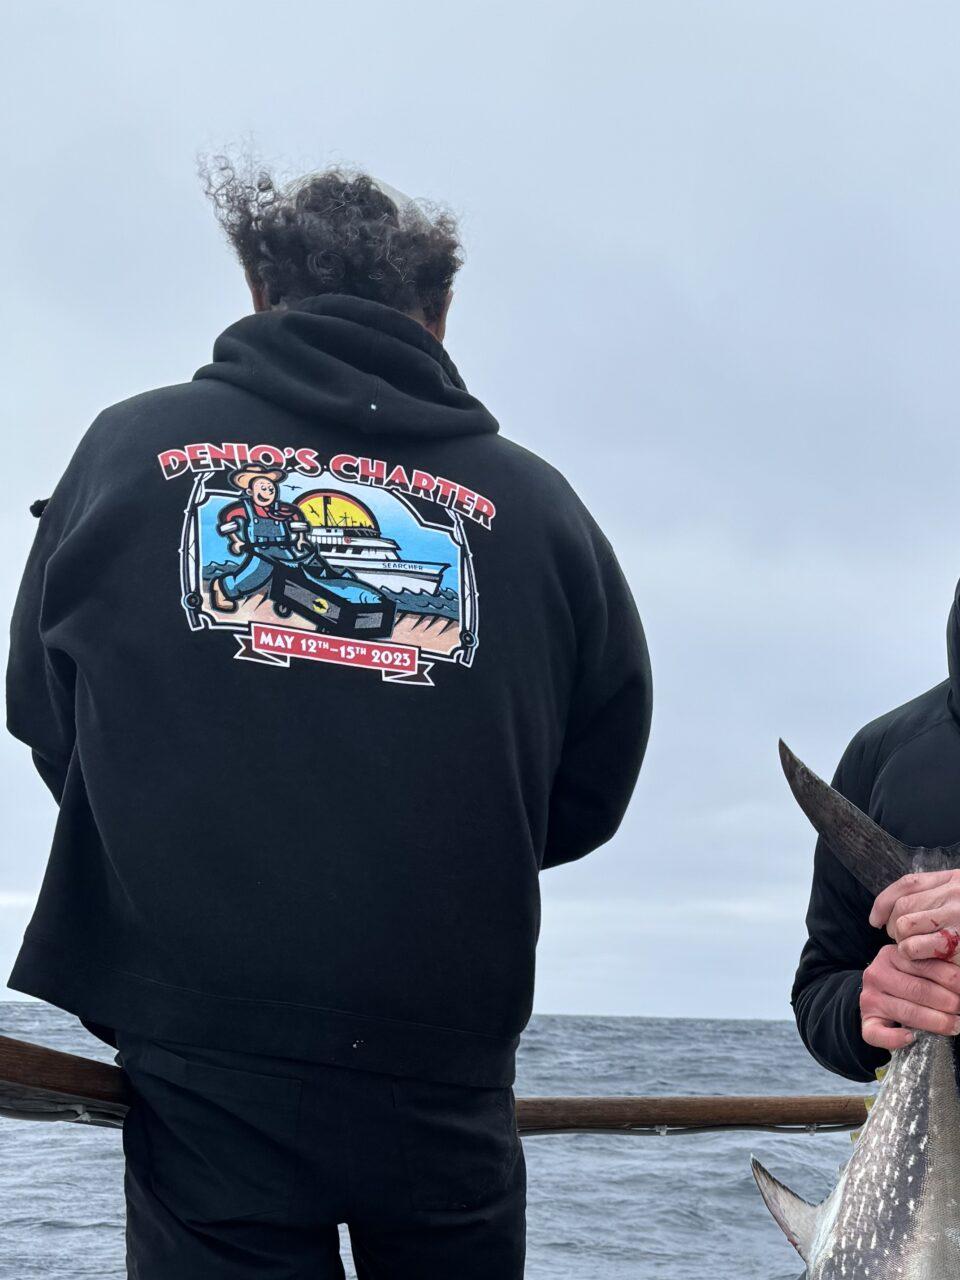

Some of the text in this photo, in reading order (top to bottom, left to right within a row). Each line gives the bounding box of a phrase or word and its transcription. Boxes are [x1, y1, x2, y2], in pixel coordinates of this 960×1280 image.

[158, 442, 496, 531] DENIO'S CHARTER
[382, 562, 424, 571] SEARCHER
[259, 631, 295, 649] MAY
[371, 649, 411, 667] 2023
